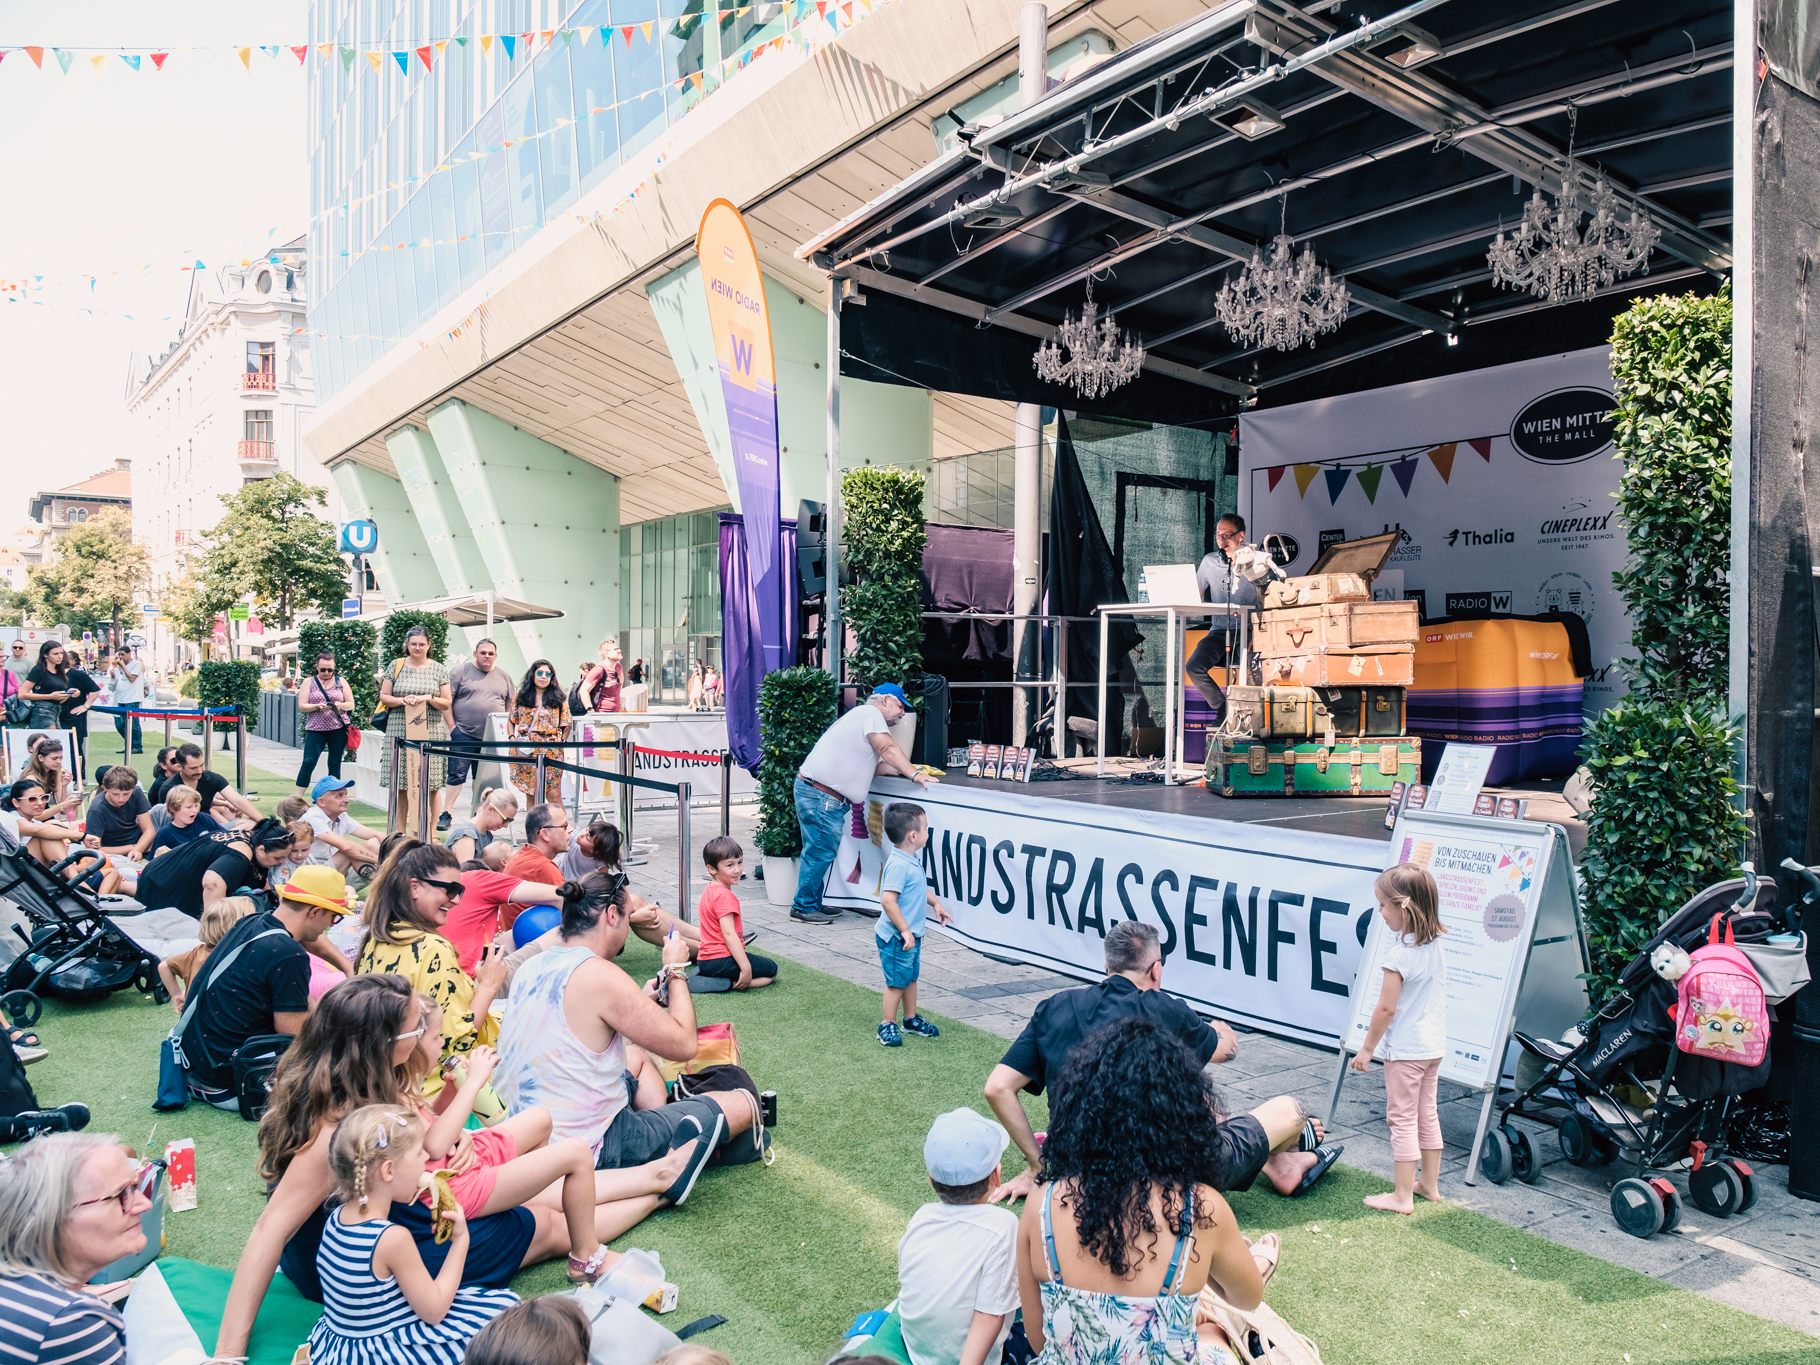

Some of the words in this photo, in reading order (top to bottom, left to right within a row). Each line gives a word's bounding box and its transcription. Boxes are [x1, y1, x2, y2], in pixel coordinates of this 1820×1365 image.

[730, 334, 753, 376] W
[1522, 417, 1561, 434] WIEN
[1539, 434, 1560, 444] THE
[1565, 429, 1595, 441] MALL
[1540, 510, 1614, 535] CINEPLEXX
[348, 526, 371, 548] U
[1462, 528, 1515, 546] Thalia
[1537, 536, 1561, 545] UNSERE
[1562, 535, 1578, 543] WELT
[1593, 533, 1616, 541] KINOS.
[1450, 597, 1488, 610] RADIO
[1493, 595, 1510, 610] W
[1426, 634, 1443, 643] ORF
[1437, 846, 1454, 857] VON
[1453, 848, 1497, 863] ZUSCHAUEN
[1434, 858, 1446, 869] BIS
[921, 827, 1375, 996] ANDSTRASSENFE
[1592, 1028, 1633, 1069] MACLAREN
